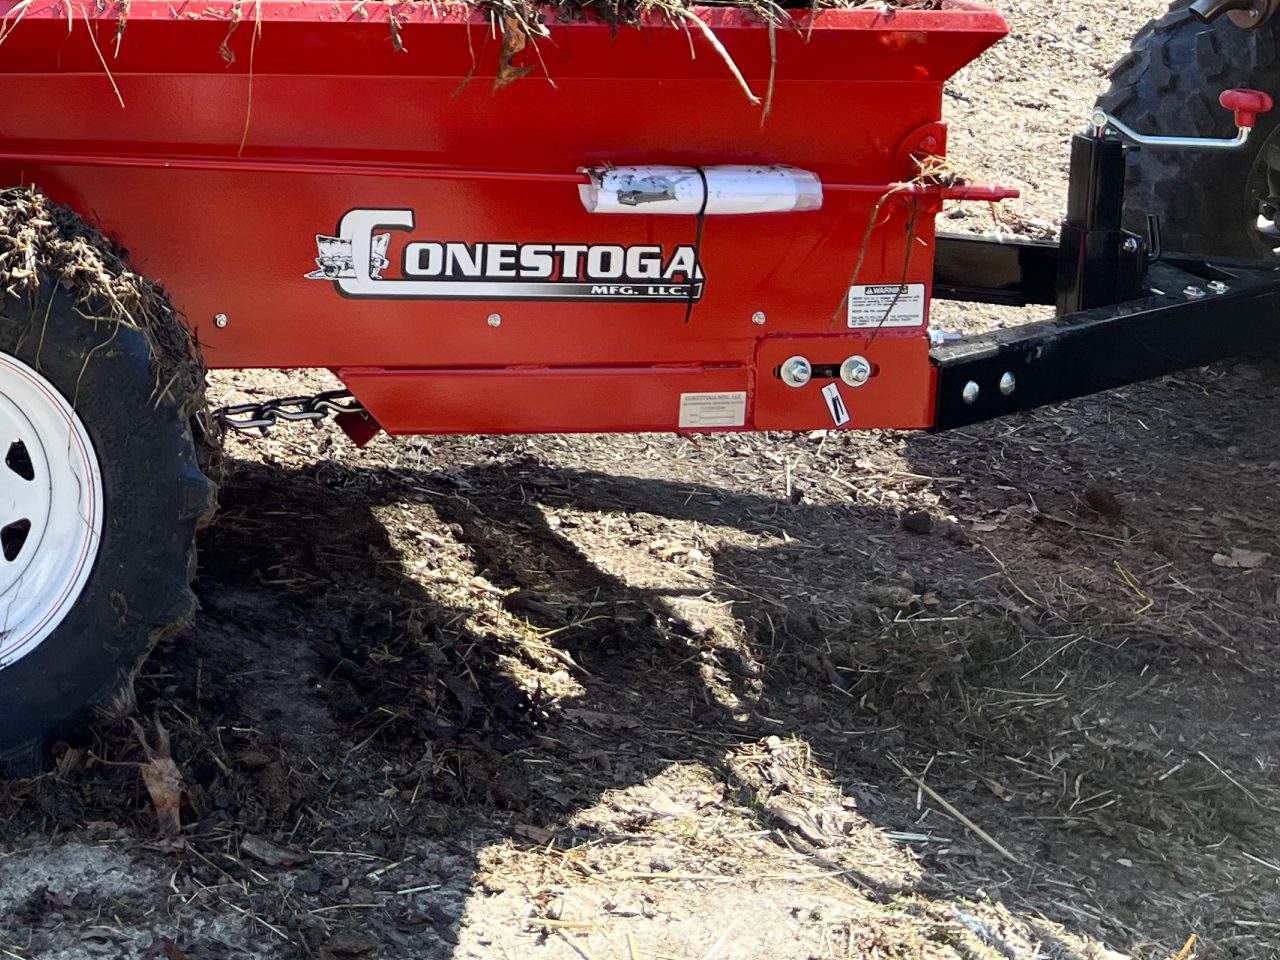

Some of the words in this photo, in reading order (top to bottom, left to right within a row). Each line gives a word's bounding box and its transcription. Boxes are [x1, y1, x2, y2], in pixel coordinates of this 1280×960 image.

[337, 208, 704, 296] CONESTOGA
[590, 285, 639, 295] MFG.
[647, 286, 688, 296] LLC.
